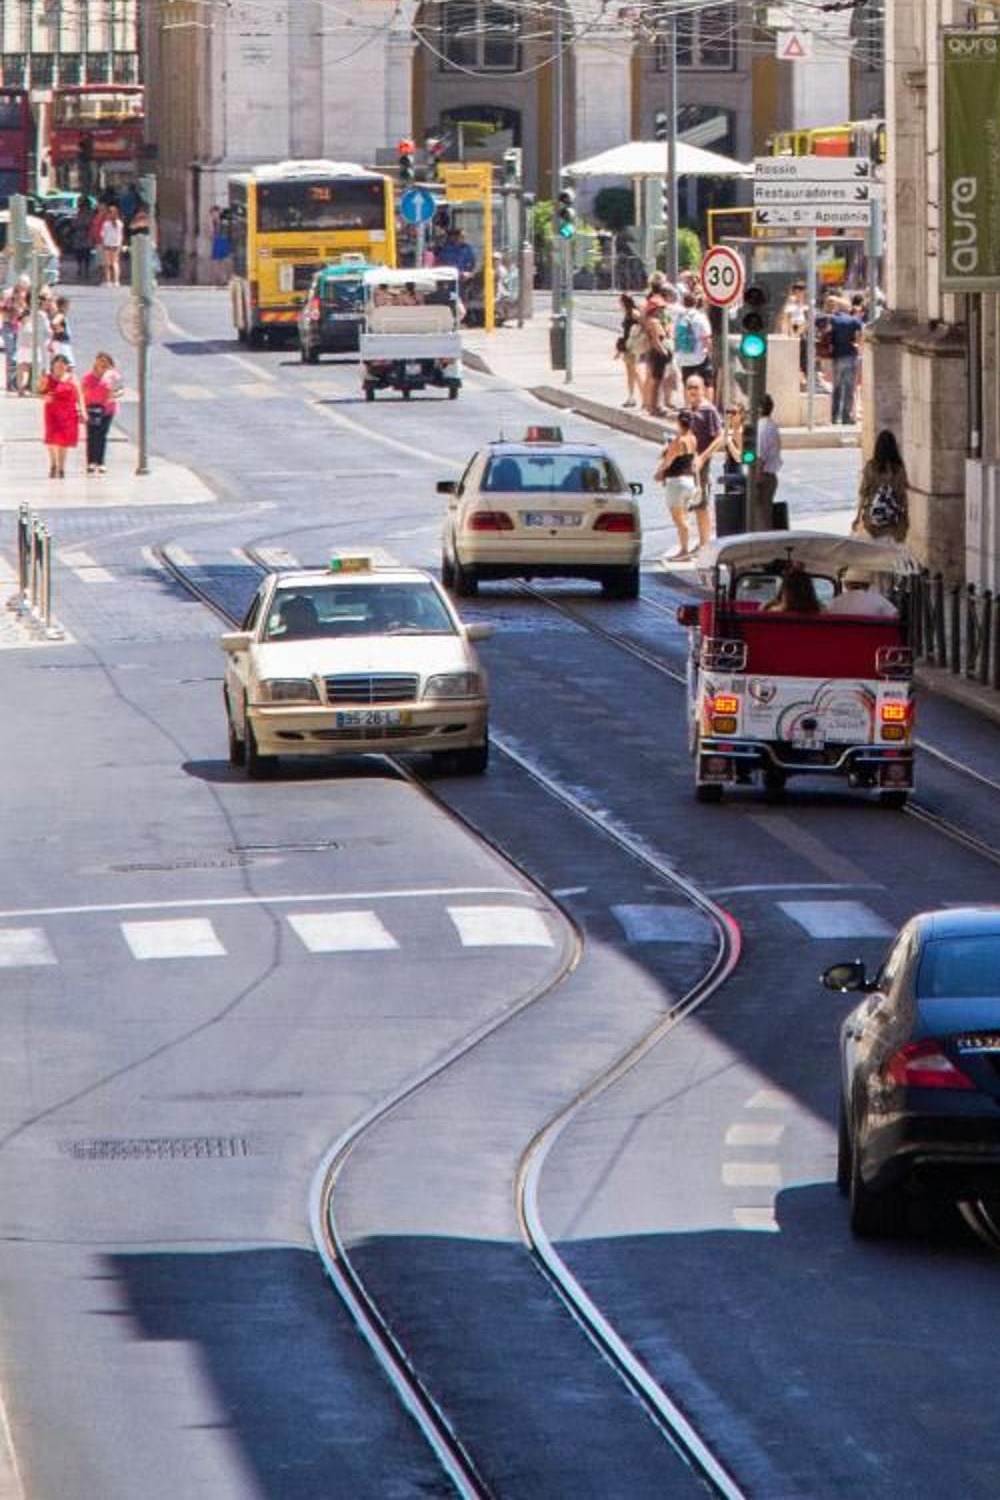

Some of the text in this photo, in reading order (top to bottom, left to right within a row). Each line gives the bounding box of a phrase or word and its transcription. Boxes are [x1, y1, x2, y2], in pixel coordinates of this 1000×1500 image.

[755, 163, 797, 174] Rossio
[755, 187, 846, 198] Restauradores
[952, 176, 978, 273] aura
[708, 266, 735, 286] 30
